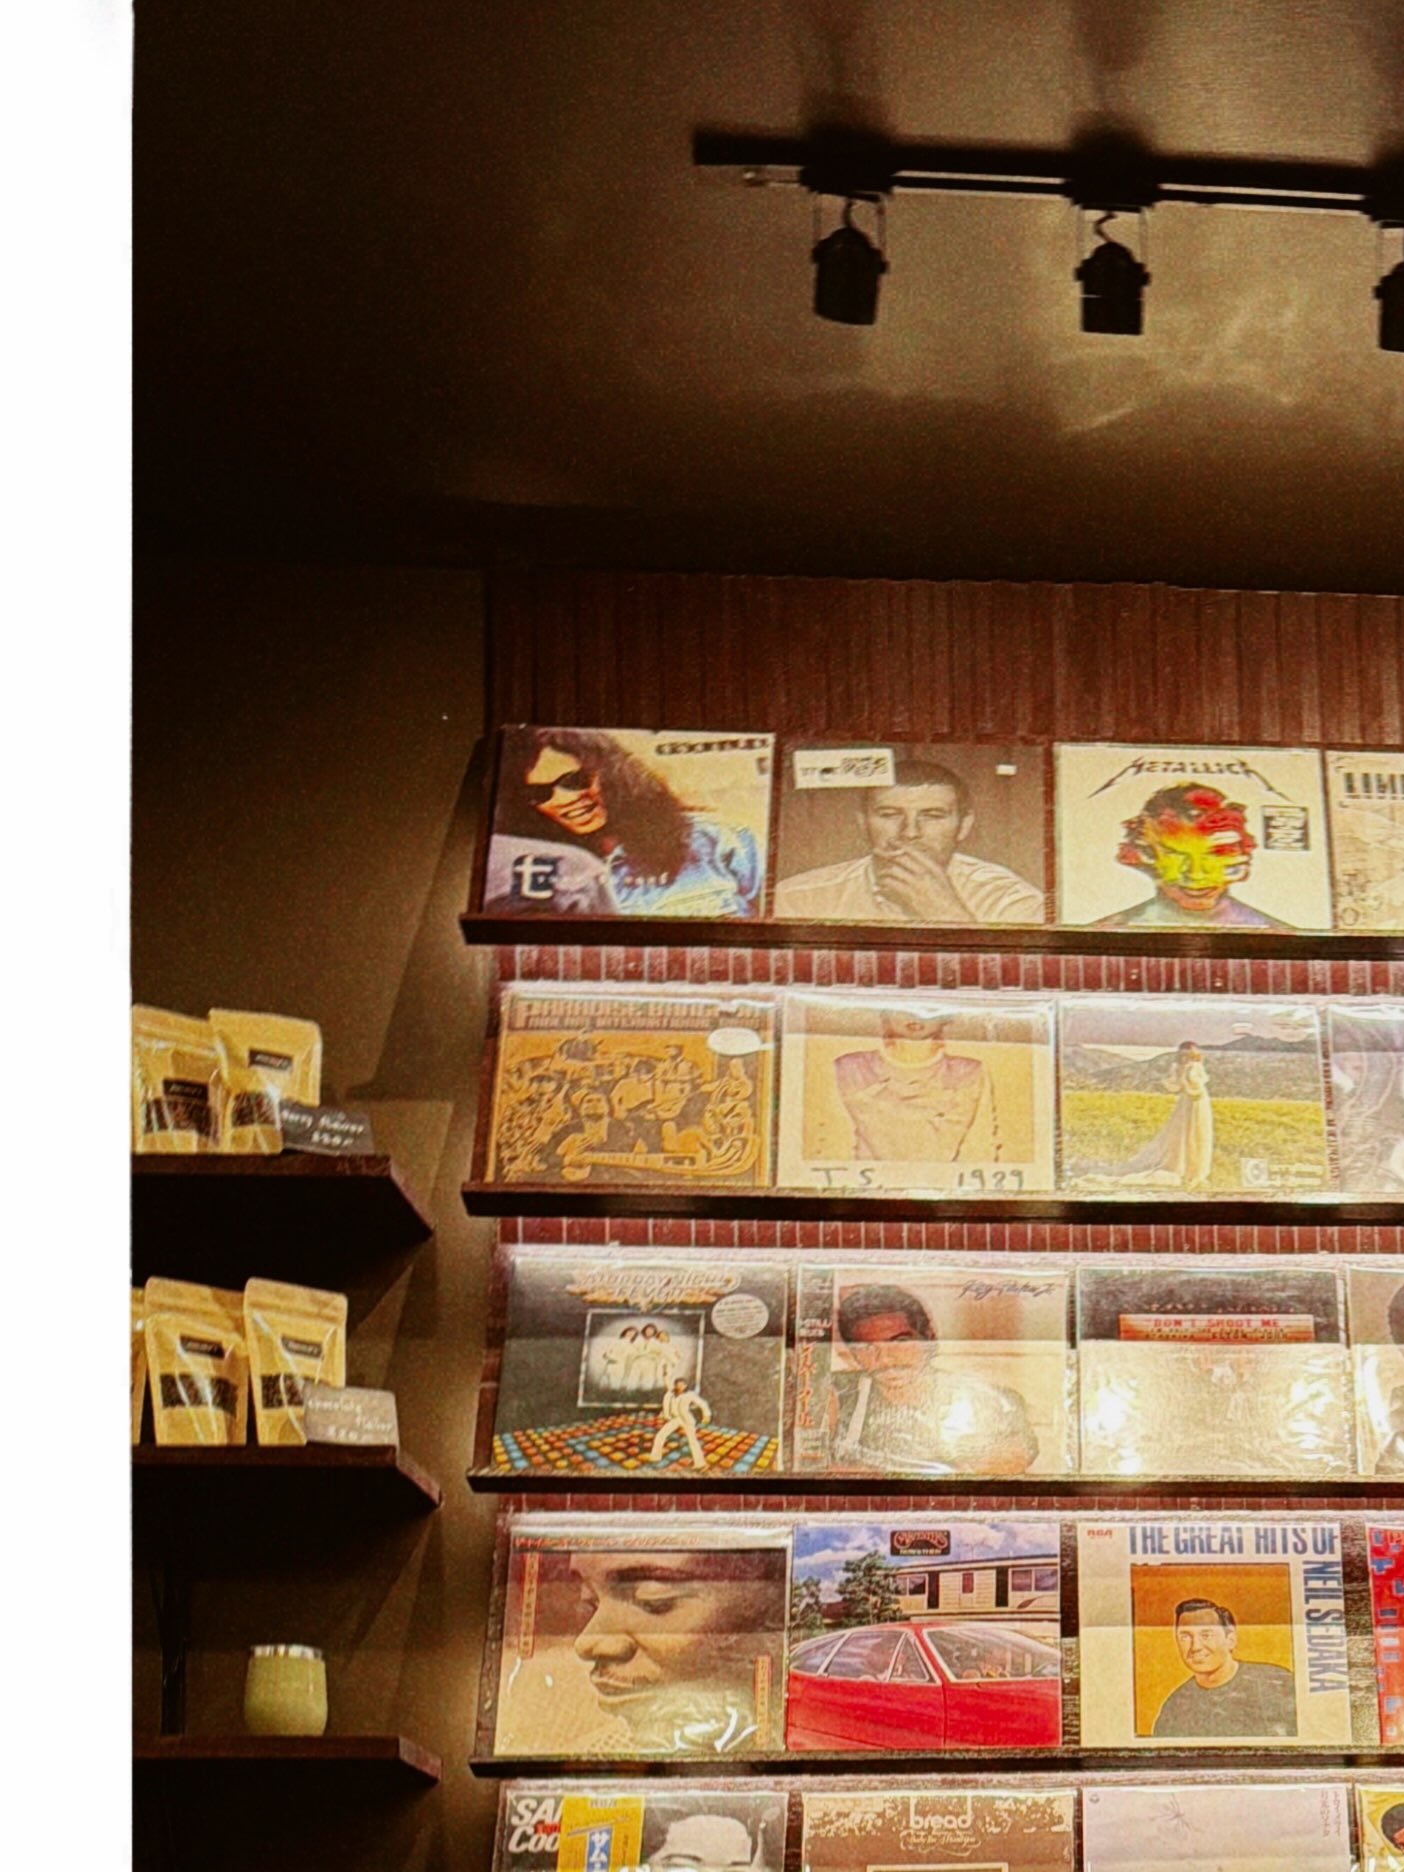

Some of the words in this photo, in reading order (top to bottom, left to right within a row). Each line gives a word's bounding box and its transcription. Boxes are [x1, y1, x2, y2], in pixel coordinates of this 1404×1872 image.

[1088, 756, 1293, 801] METALLICA
[1129, 1526, 1172, 1555] THE
[1173, 1526, 1245, 1555] GREAT
[1254, 1526, 1308, 1555] HITS
[1312, 1526, 1339, 1555] OF
[1302, 1560, 1344, 1605] NEIL
[1304, 1607, 1350, 1694] SEDAKA
[909, 1796, 973, 1830] bread
